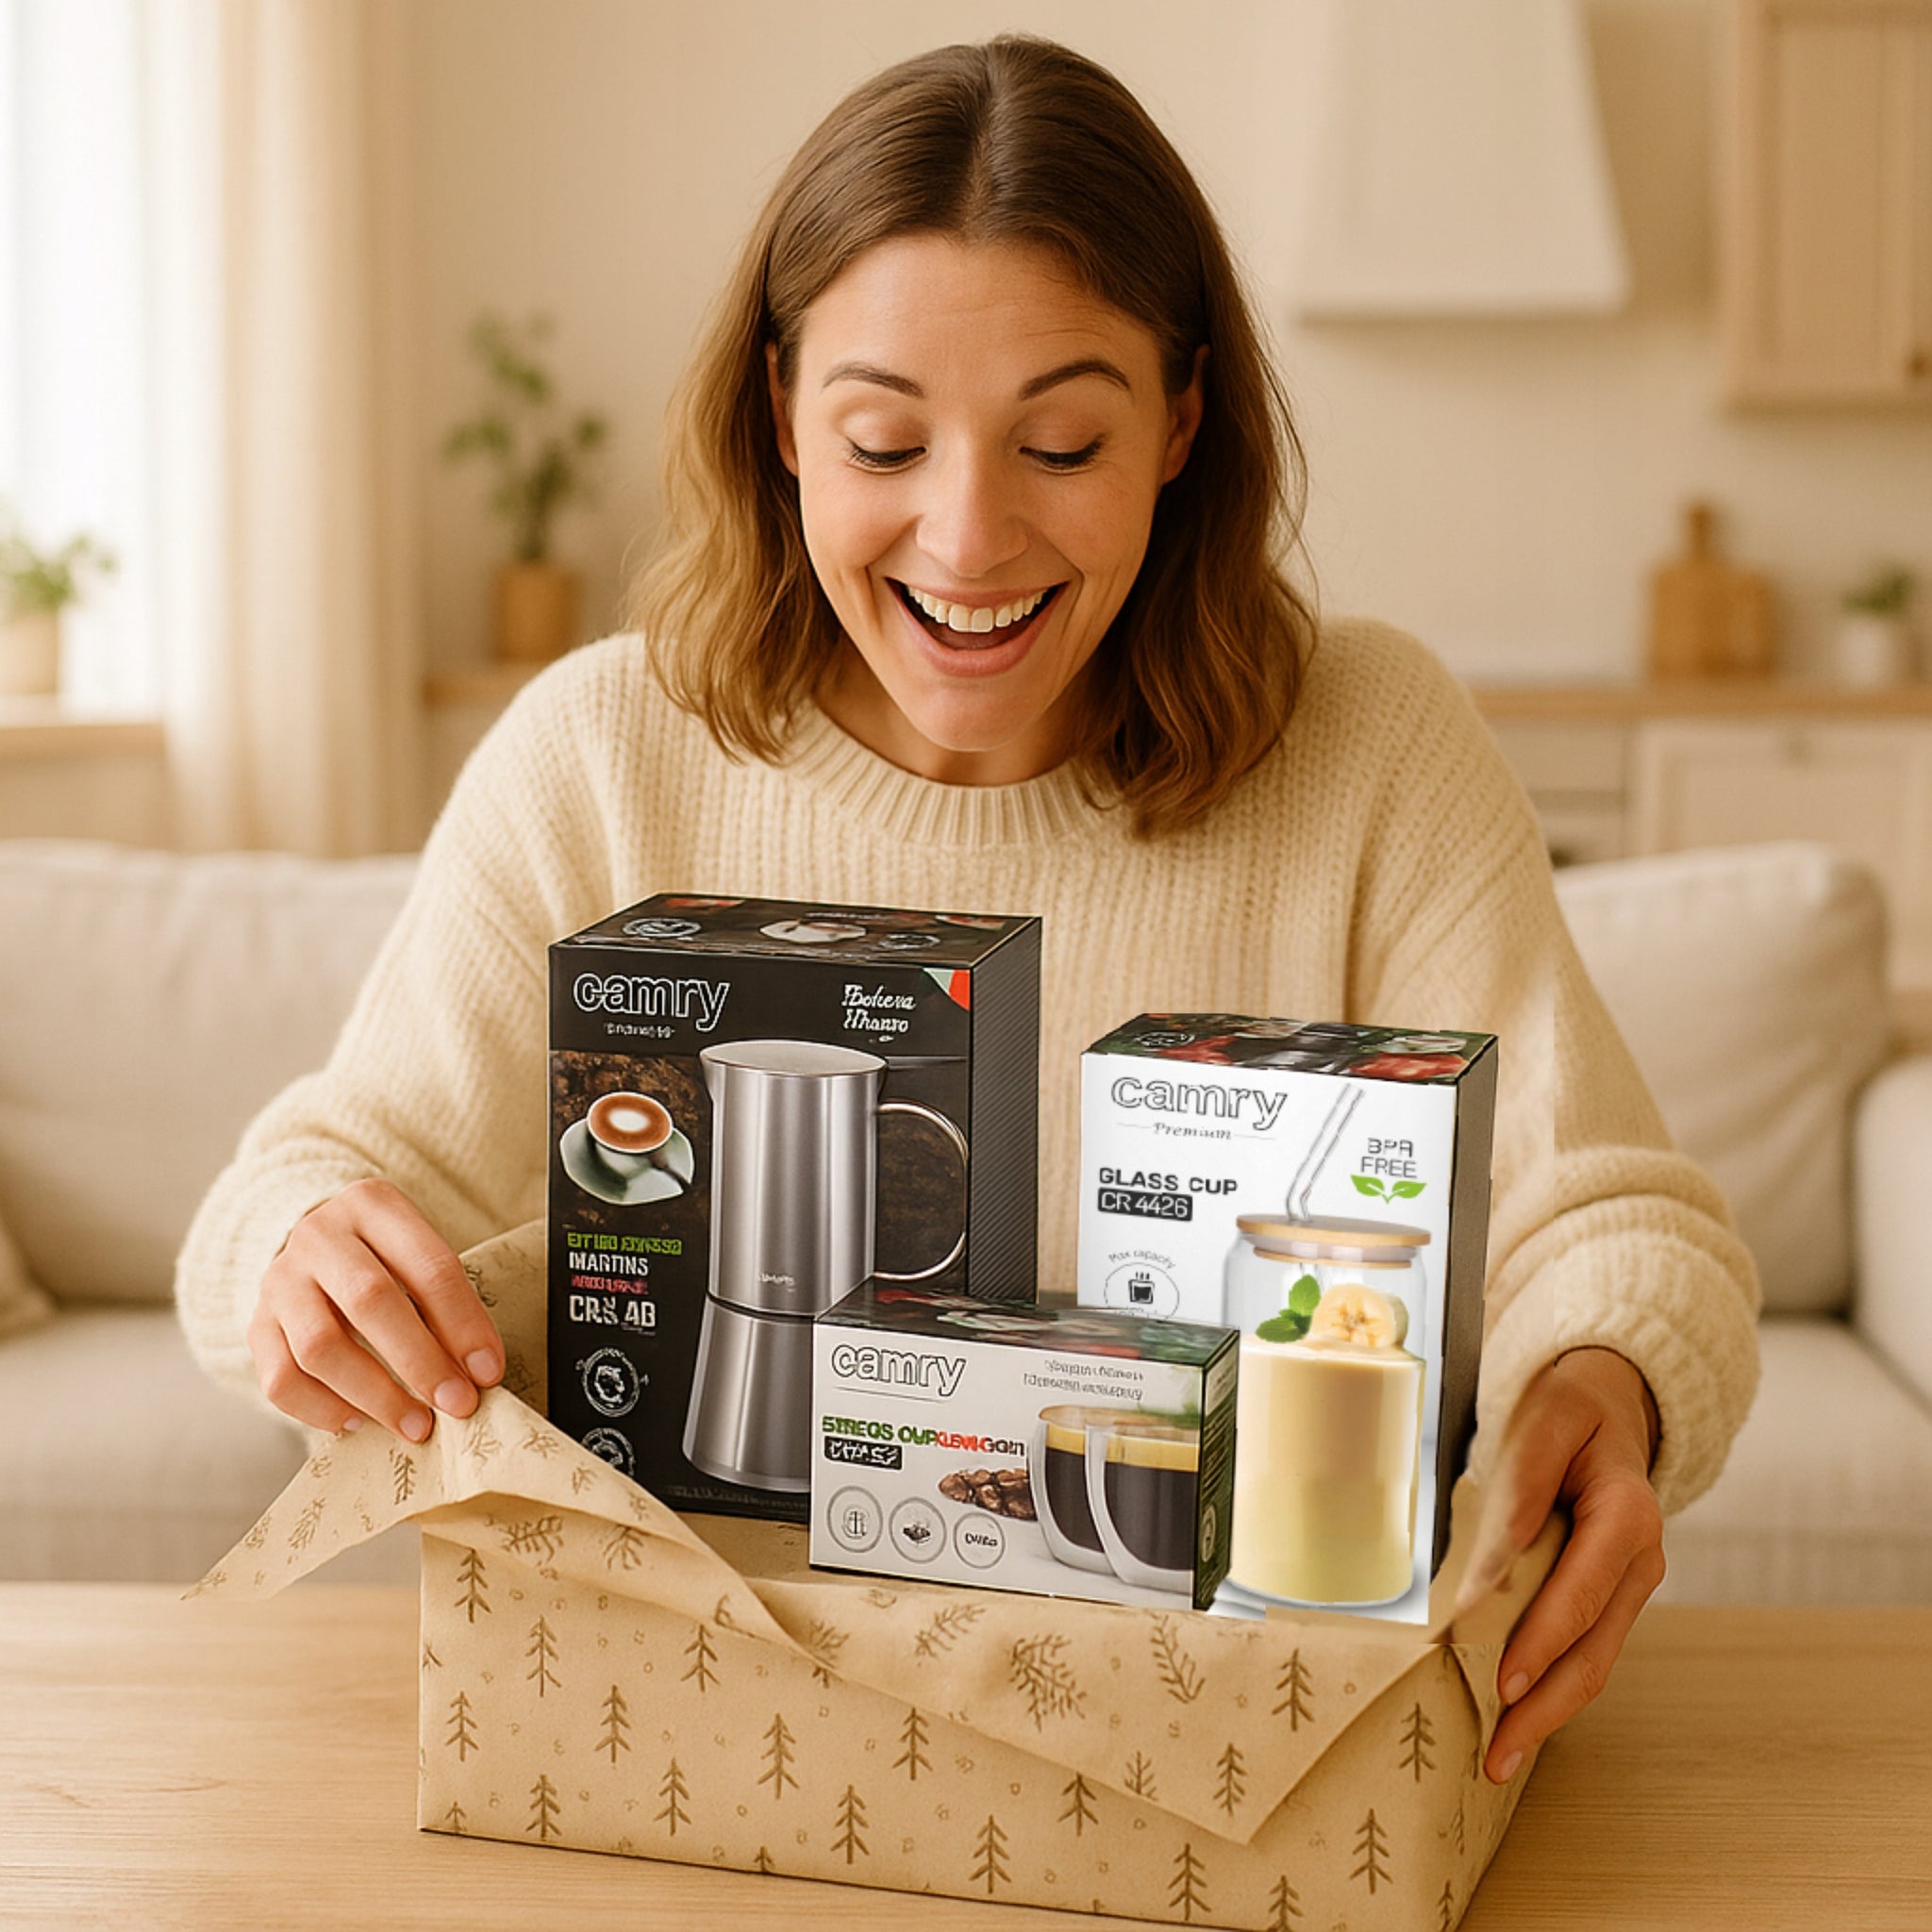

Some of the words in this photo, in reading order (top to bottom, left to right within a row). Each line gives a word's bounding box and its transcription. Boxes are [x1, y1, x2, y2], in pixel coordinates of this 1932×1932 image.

[574, 973, 731, 1032] camry
[1110, 1076, 1289, 1131] camry
[1153, 1122, 1232, 1140] Premium
[1367, 1137, 1414, 1158] BPA
[1099, 1167, 1179, 1191] GLASS
[1189, 1176, 1239, 1195] CUP
[1360, 1156, 1418, 1179] FREE
[1100, 1191, 1132, 1212] CR
[1134, 1195, 1189, 1218] 4426
[831, 1344, 967, 1396] camry
